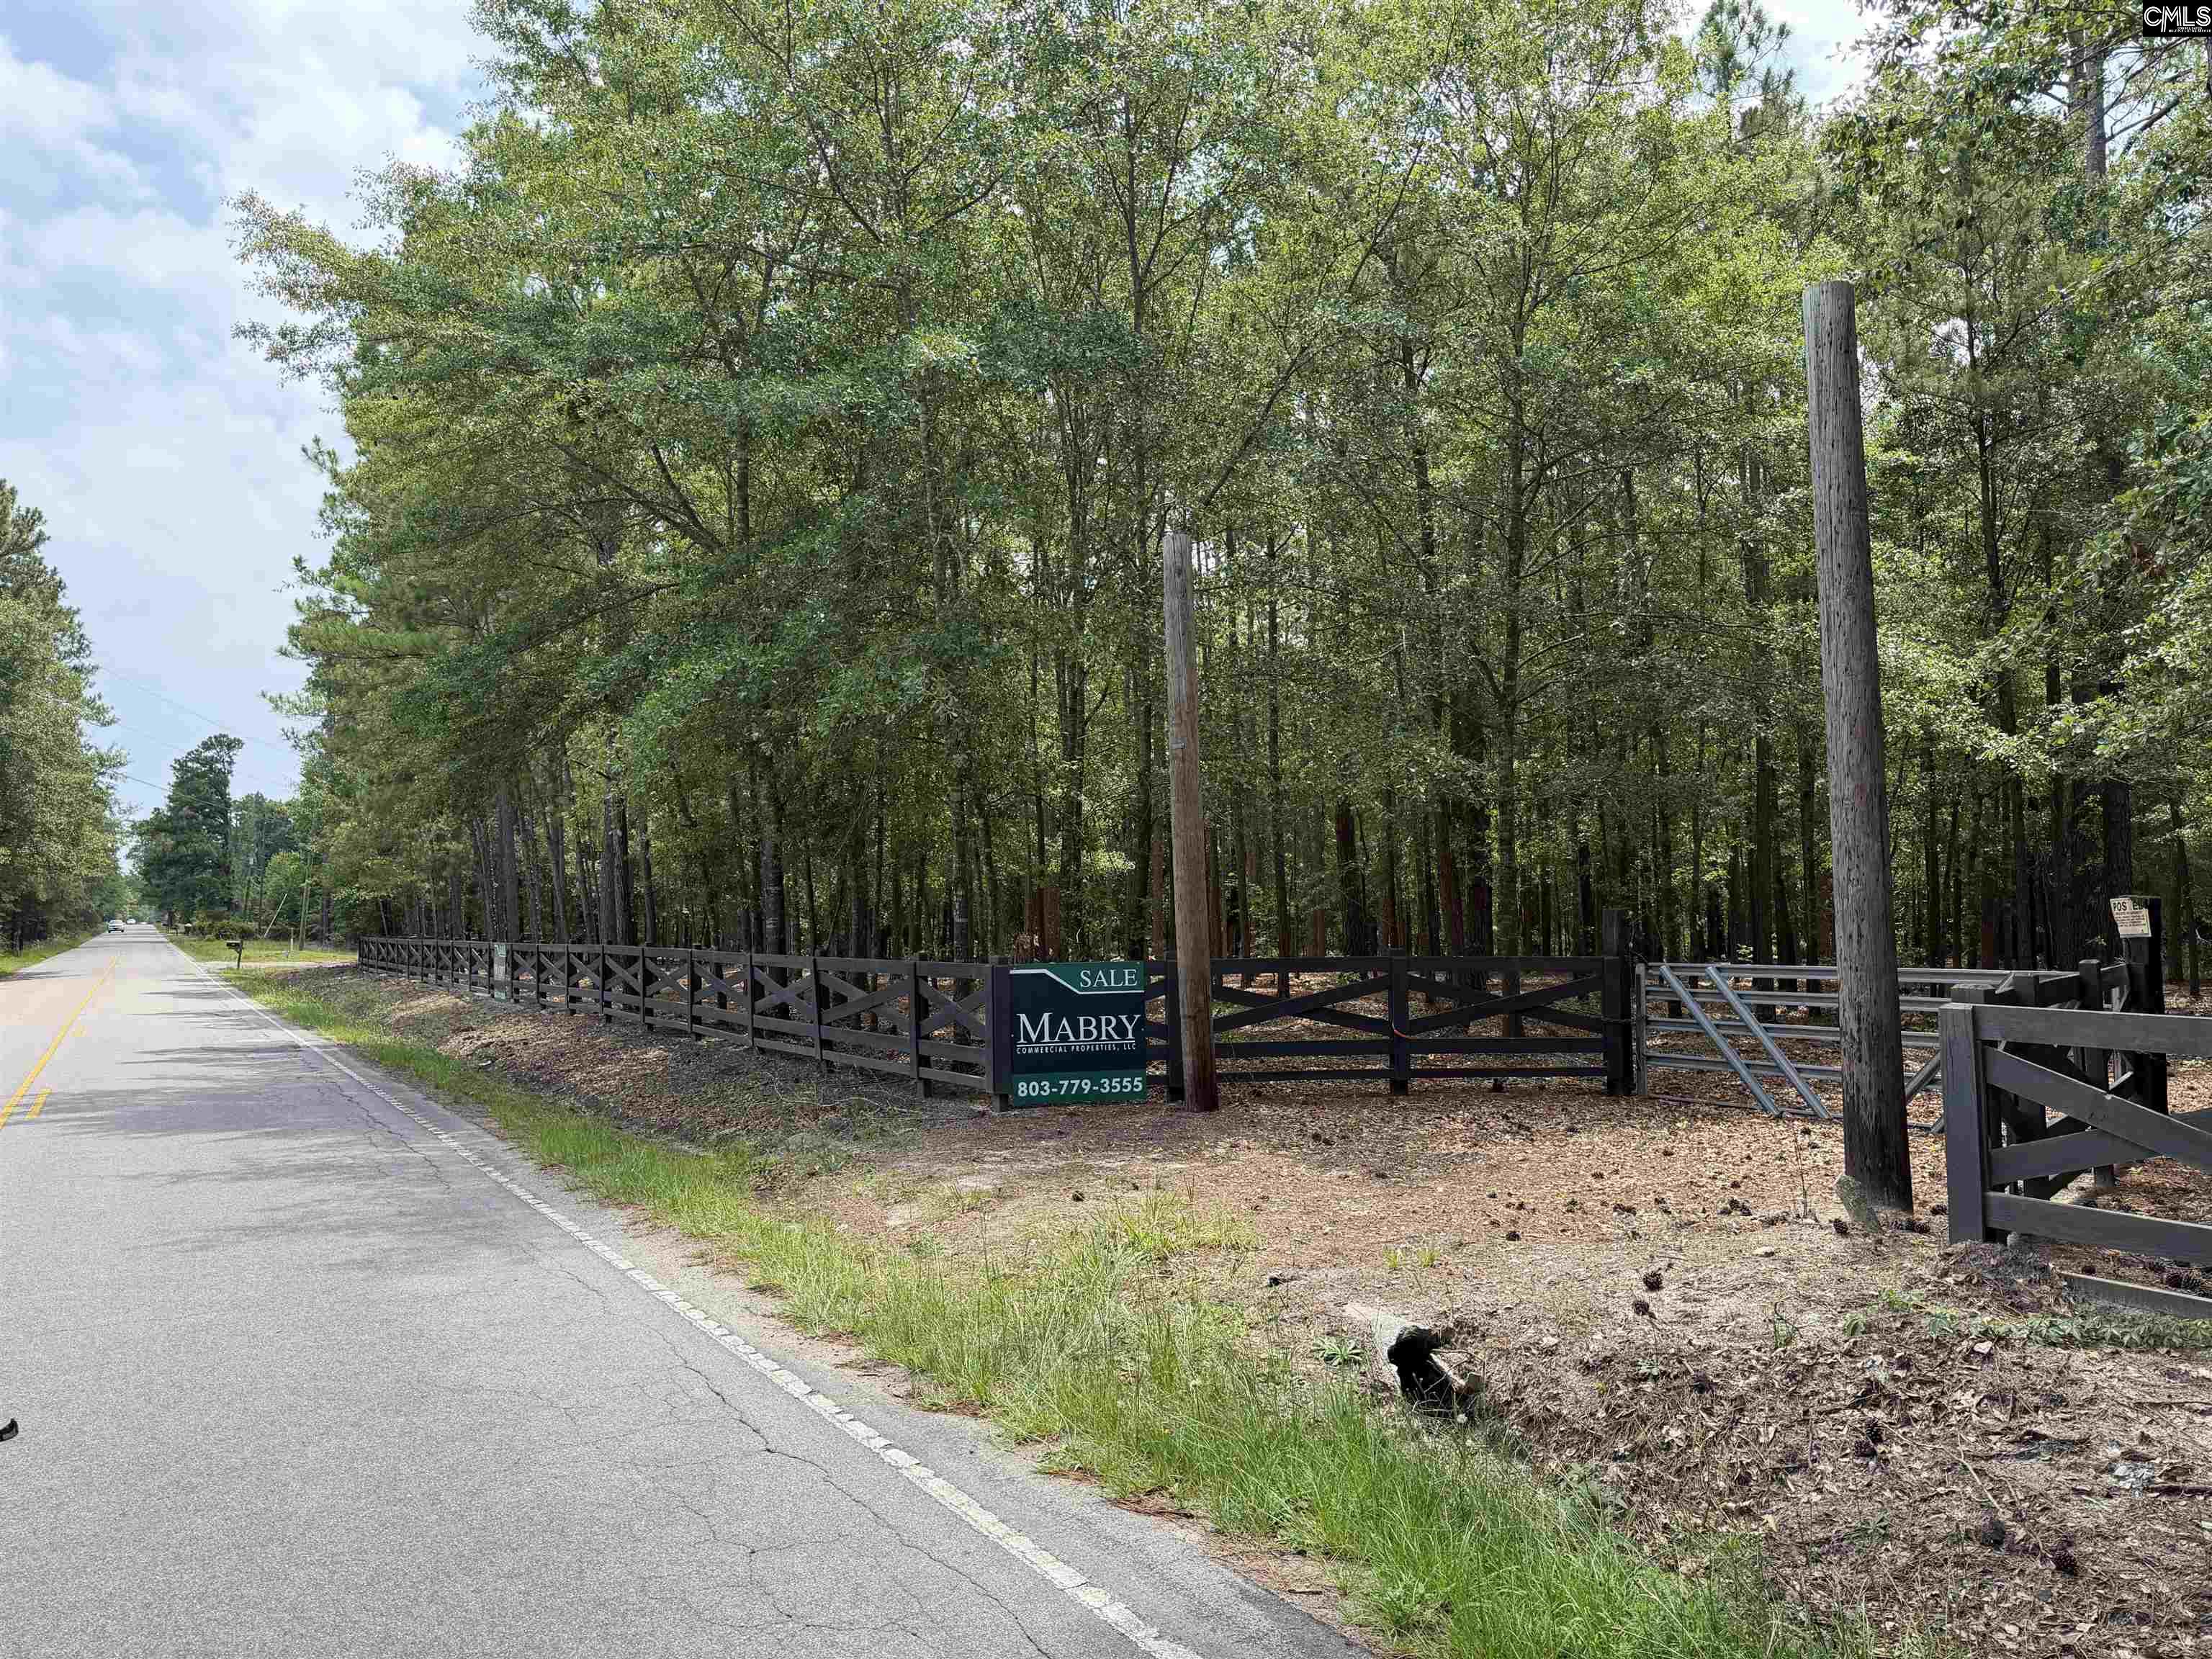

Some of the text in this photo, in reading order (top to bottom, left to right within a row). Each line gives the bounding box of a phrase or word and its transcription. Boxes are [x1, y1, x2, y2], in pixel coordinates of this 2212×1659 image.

[2113, 902, 2144, 911] POSE
[1080, 968, 1138, 988] SALE
[1016, 1046, 1067, 1054] COMMERCIAL
[1071, 1043, 1120, 1052] PROPERTIES,
[1017, 1076, 1143, 1097] 803-779-3555
